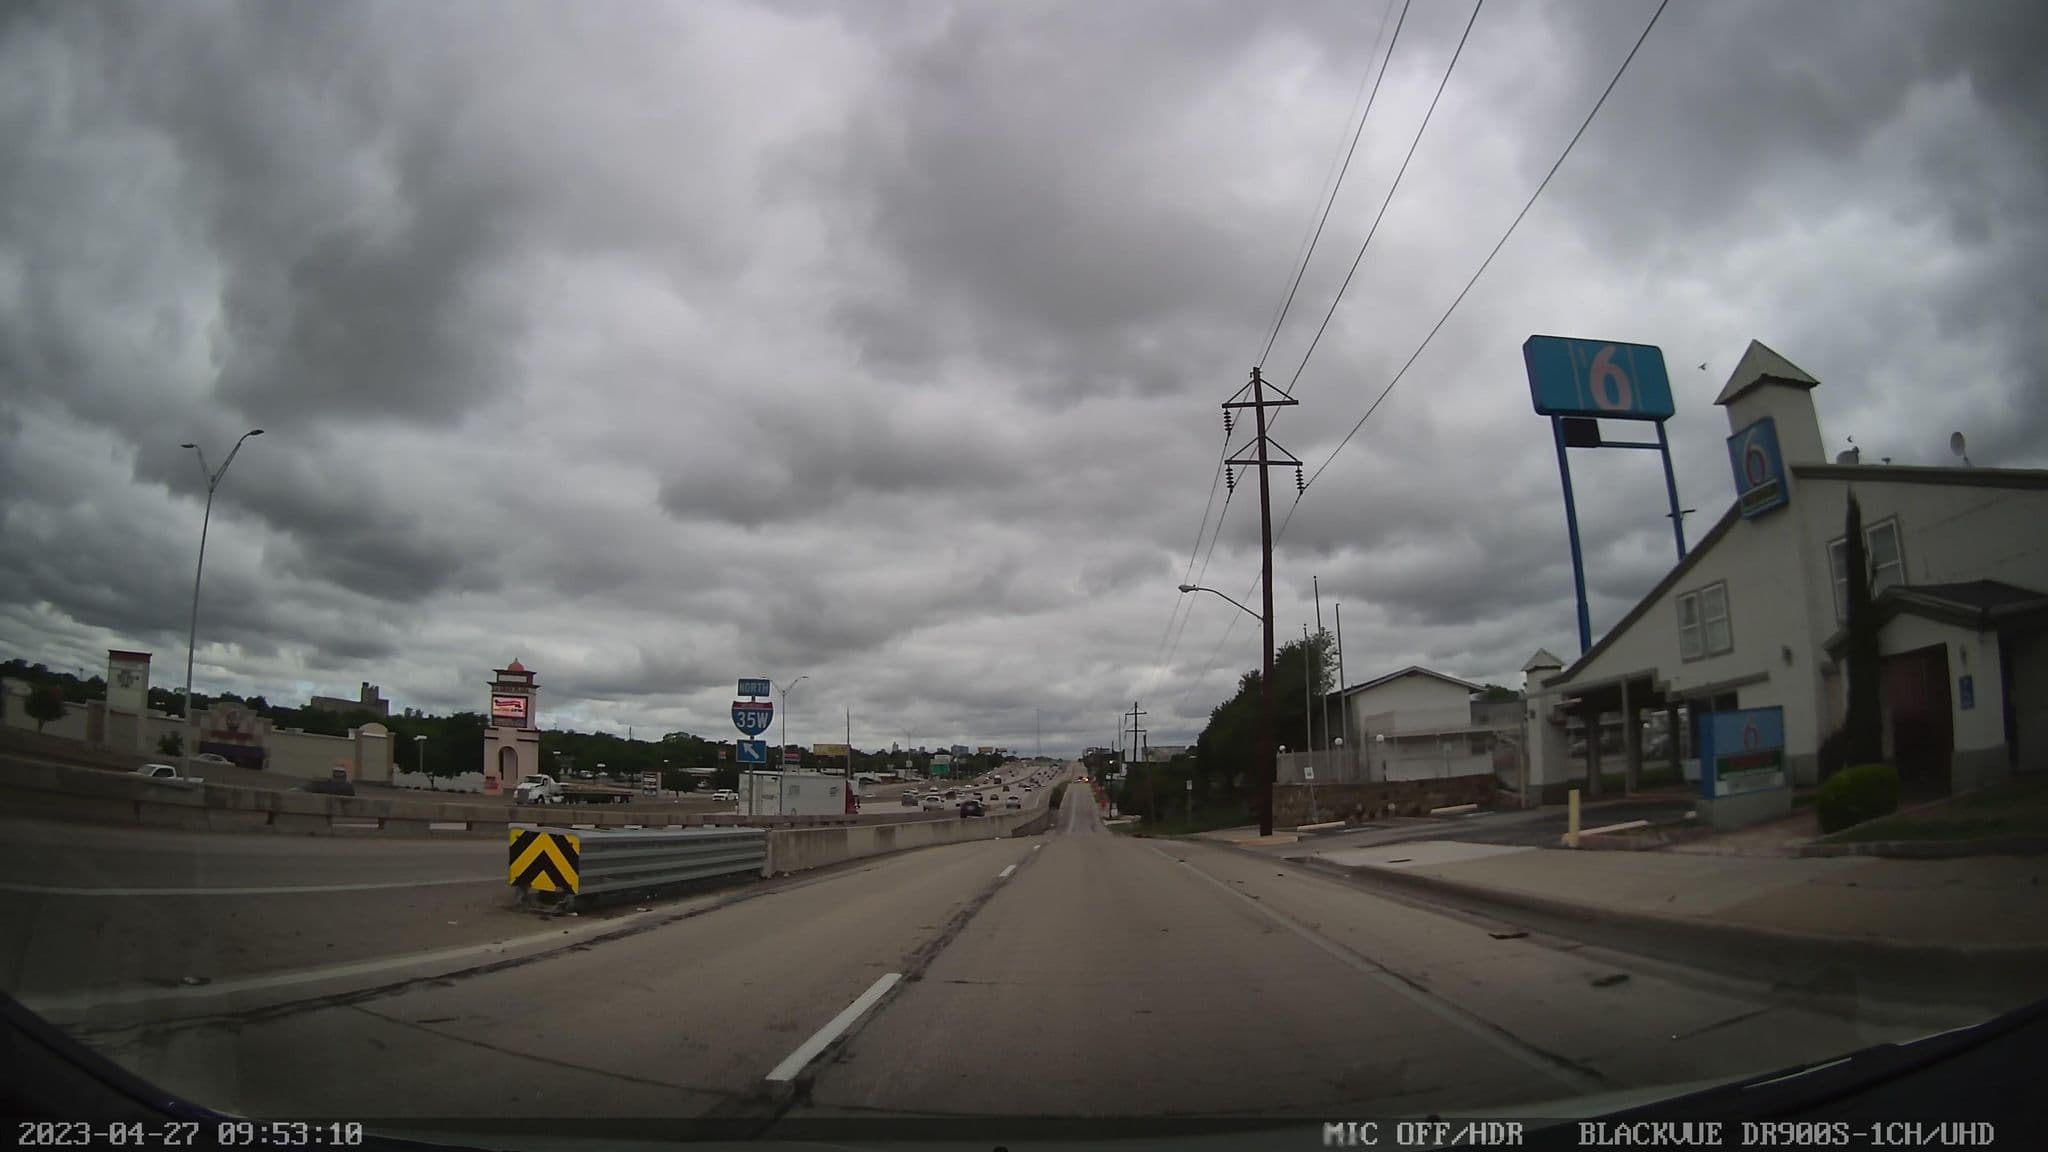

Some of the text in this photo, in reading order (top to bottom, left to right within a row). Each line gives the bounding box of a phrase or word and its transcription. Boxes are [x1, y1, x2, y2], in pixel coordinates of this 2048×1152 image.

[1589, 344, 1632, 410] 6
[1743, 425, 1771, 487] 6
[739, 682, 769, 694] NORTH
[737, 711, 769, 729] 35W
